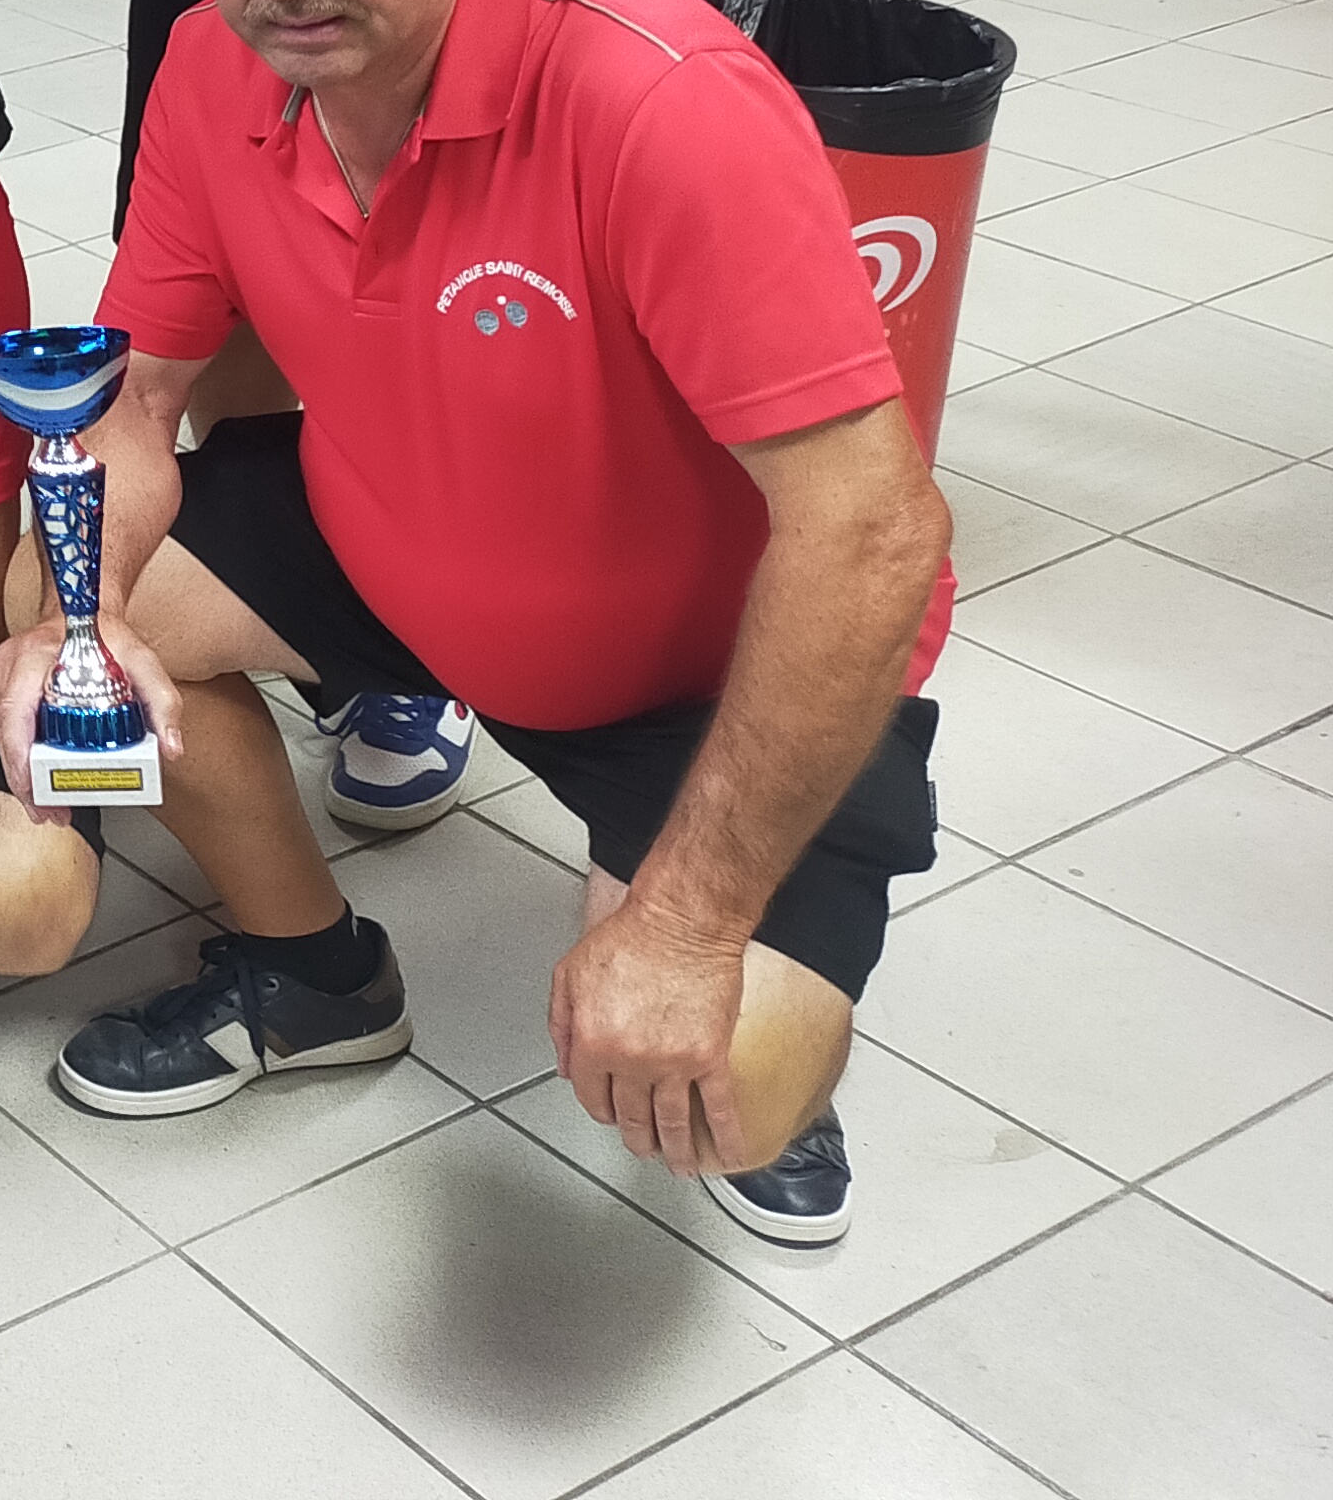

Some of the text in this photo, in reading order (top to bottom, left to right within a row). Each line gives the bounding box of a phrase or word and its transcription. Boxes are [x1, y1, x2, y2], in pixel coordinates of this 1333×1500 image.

[436, 259, 578, 321] PETANQUE SAINT REMOISE
